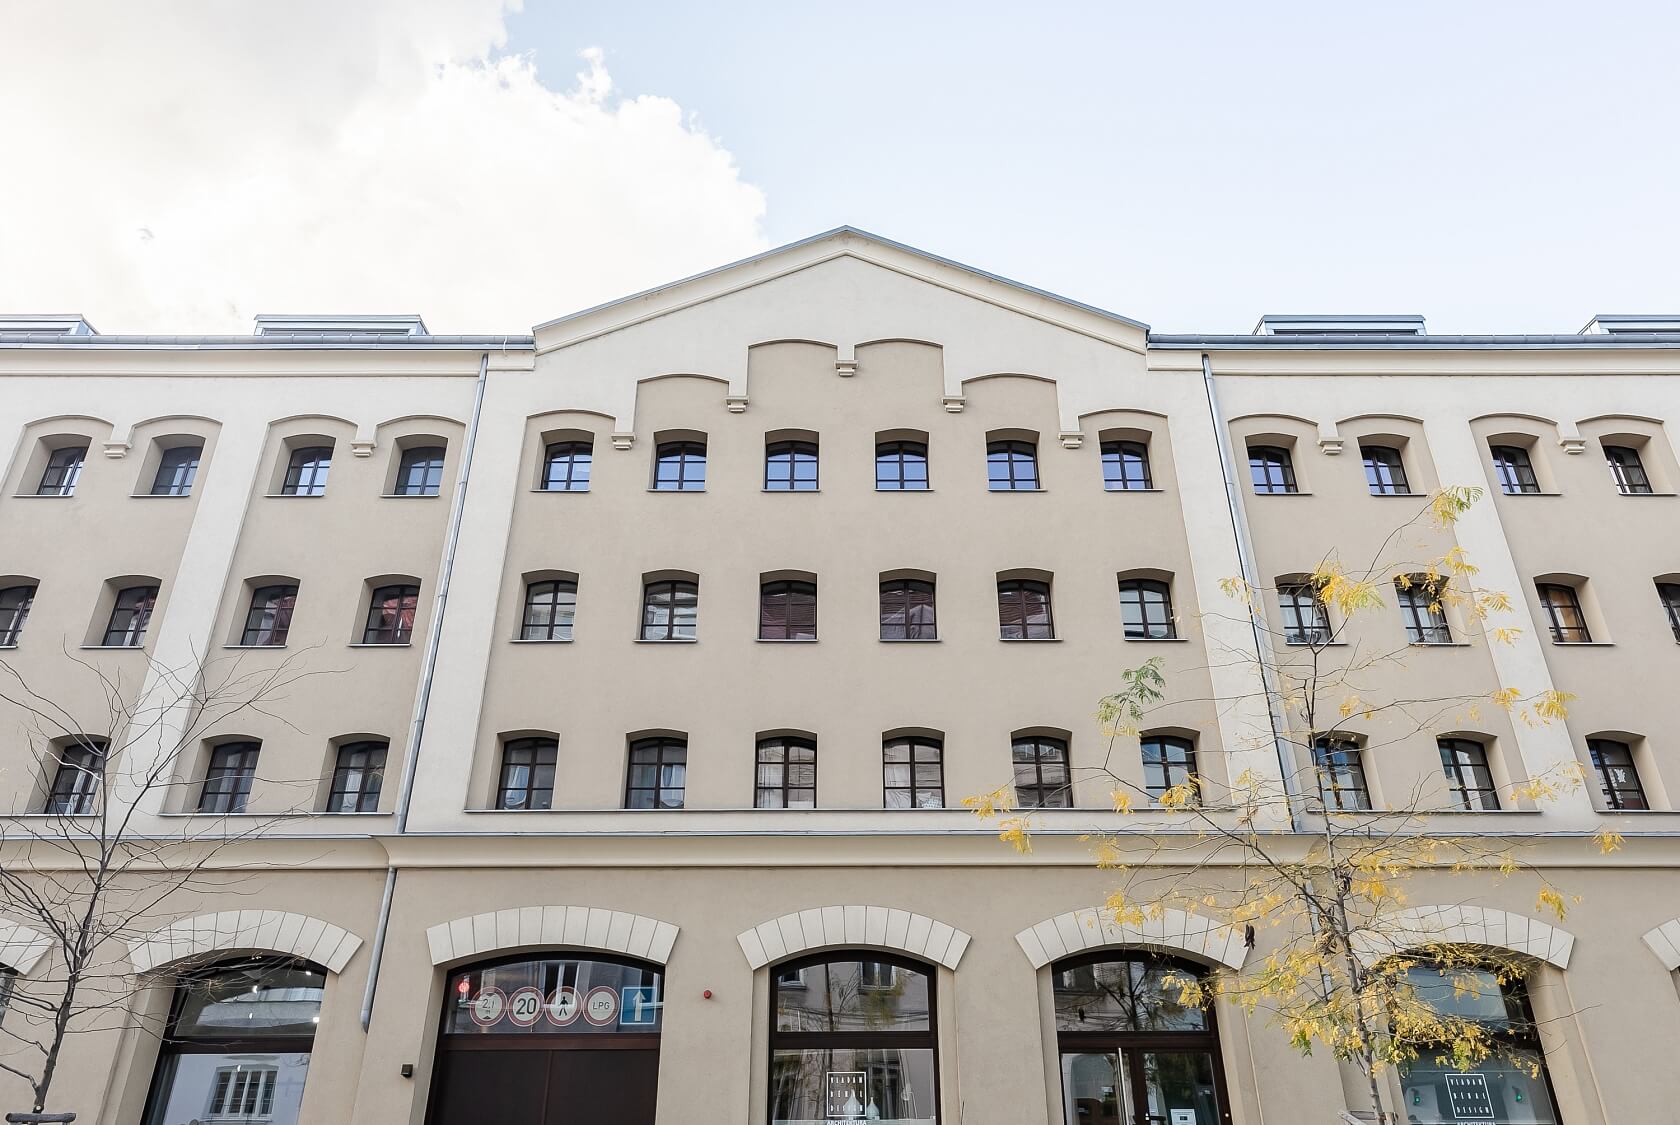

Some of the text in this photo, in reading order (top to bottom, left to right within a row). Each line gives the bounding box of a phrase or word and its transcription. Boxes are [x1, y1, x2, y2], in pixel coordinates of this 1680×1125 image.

[515, 997, 537, 1015] 20
[592, 1001, 610, 1011] LPG
[1456, 1106, 1489, 1114] DESIGN
